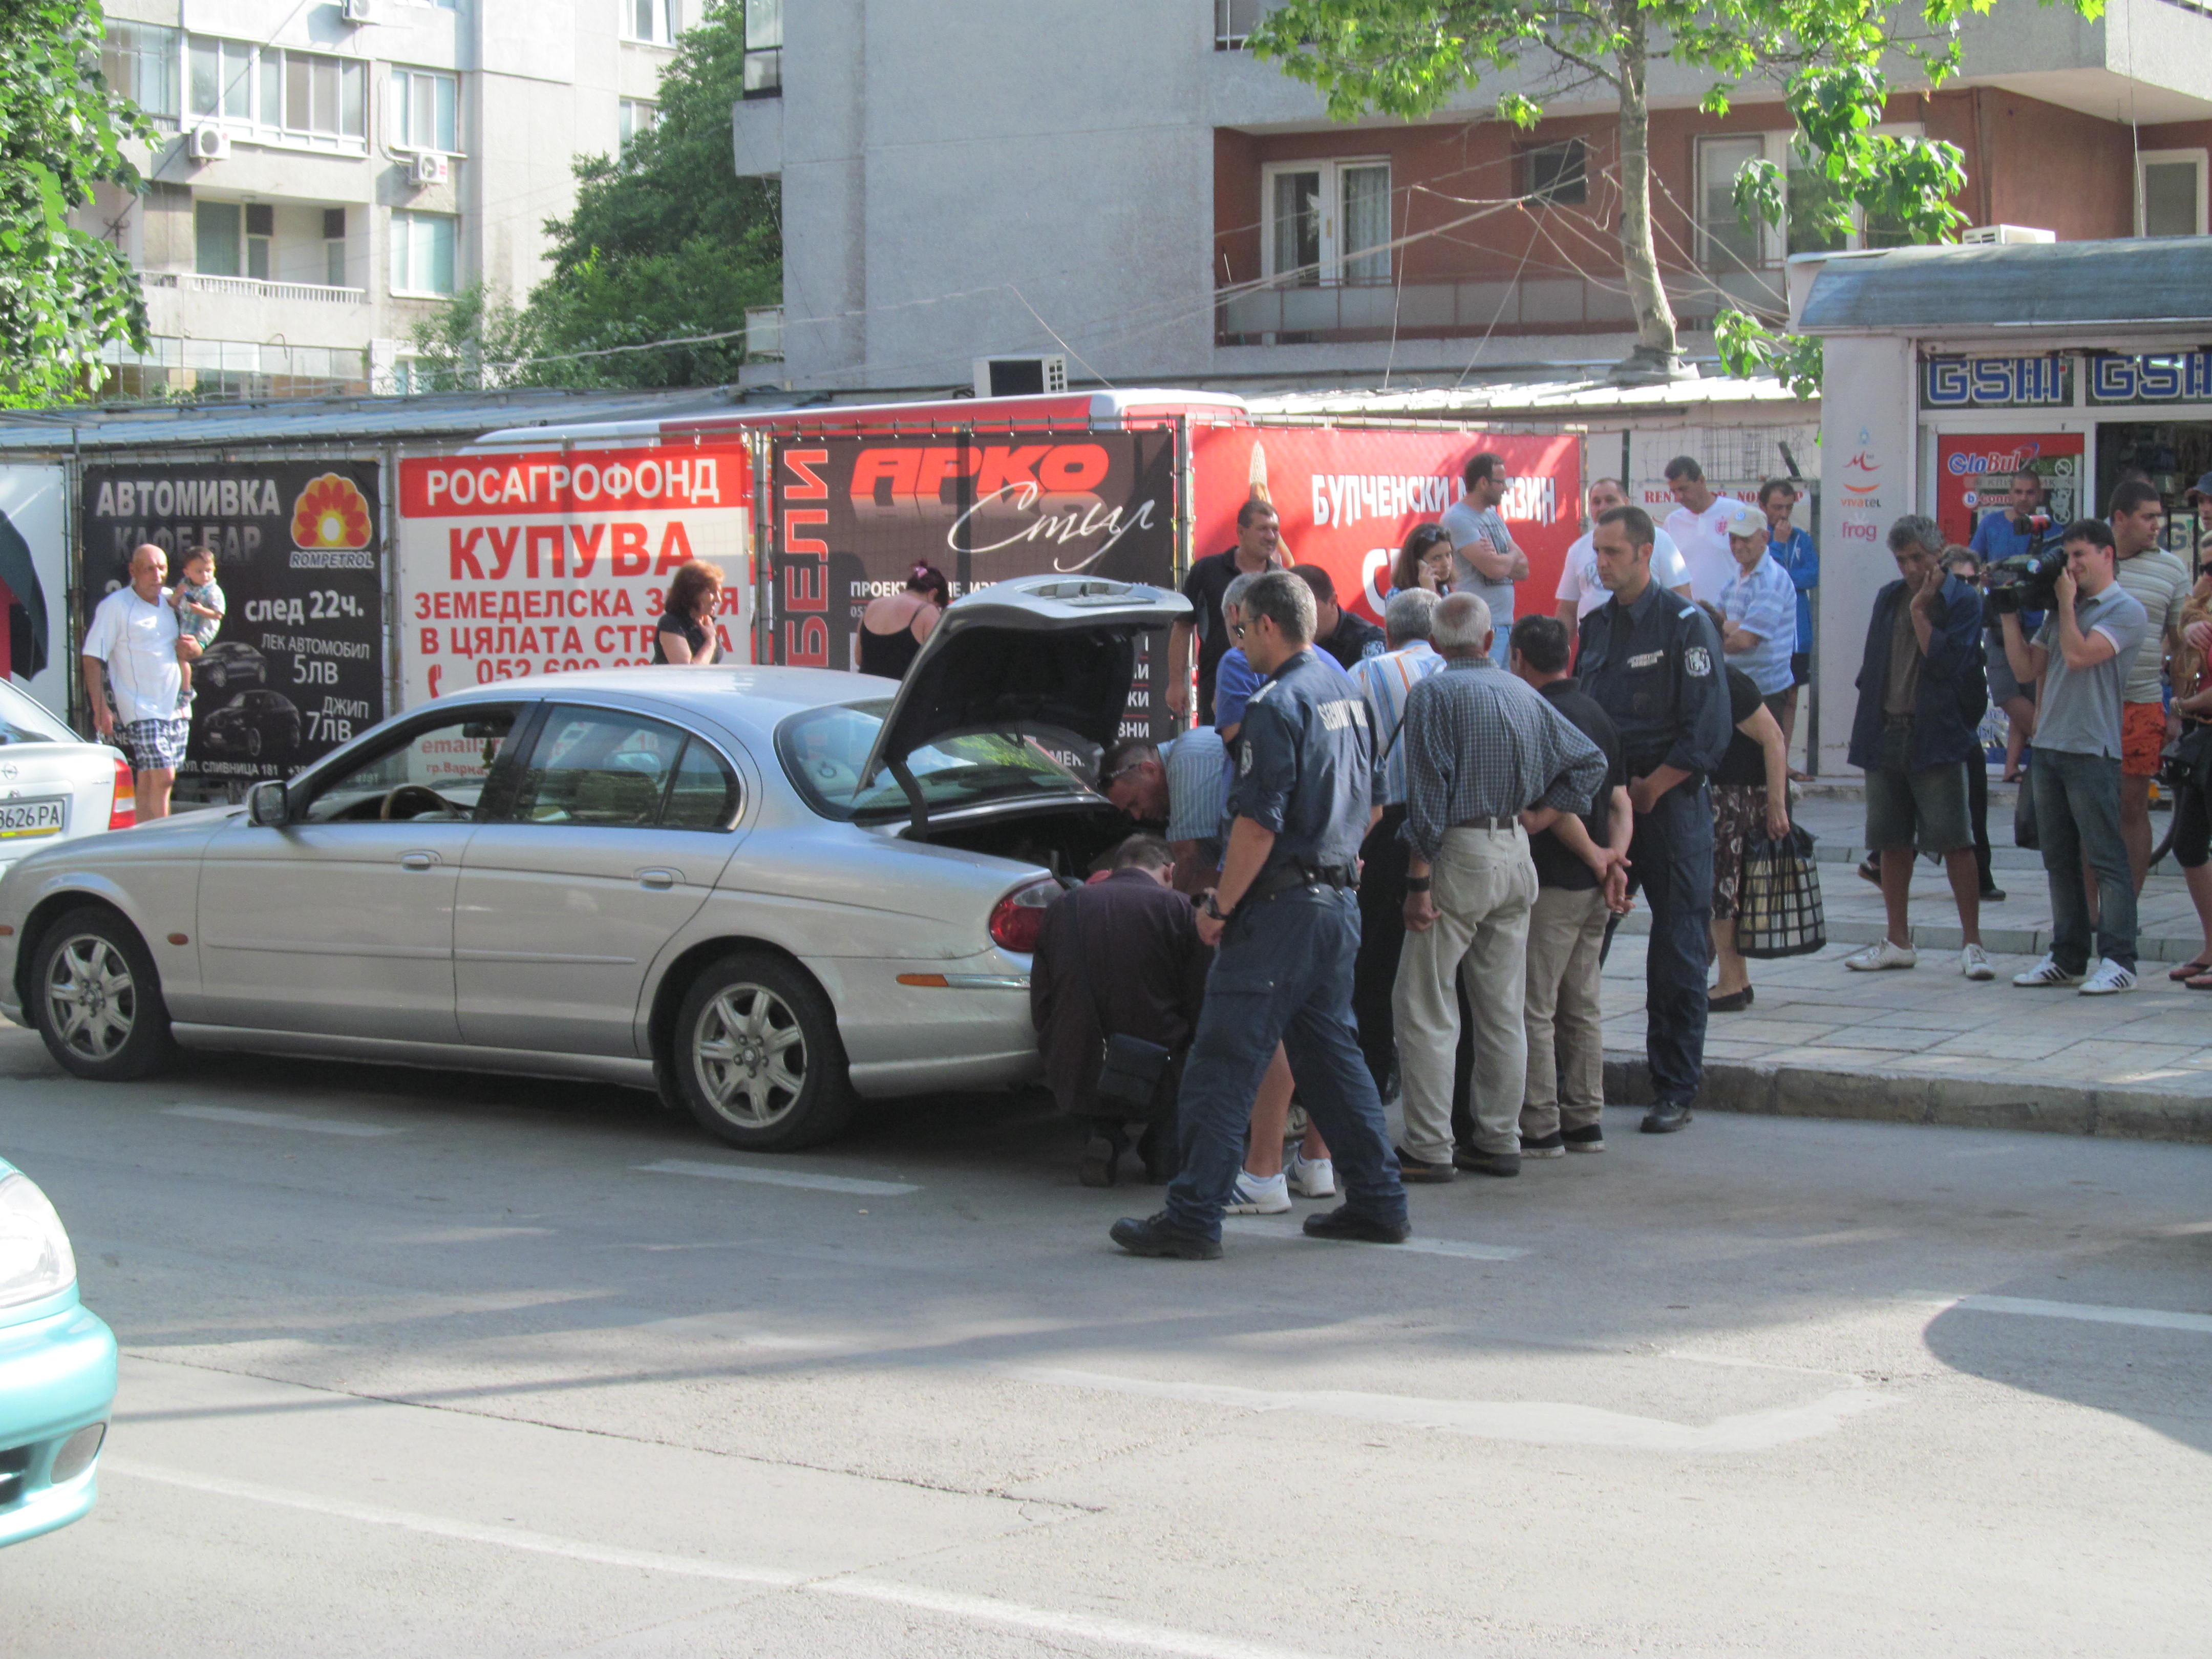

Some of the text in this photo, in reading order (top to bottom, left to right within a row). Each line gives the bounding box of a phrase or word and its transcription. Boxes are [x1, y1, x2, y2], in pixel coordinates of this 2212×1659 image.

[1927, 357, 2064, 405] GSM
[427, 459, 720, 506] РОСАГРОФОНД
[850, 443, 1110, 494] АРКО
[96, 479, 281, 517] АВТОМИВКА
[1312, 474, 1450, 529] БУЛЧЕНСКИ
[202, 526, 262, 563] БАР
[947, 481, 1155, 573] Стил
[1842, 521, 1877, 542] frog
[289, 550, 374, 569] ROMPETROL
[449, 521, 695, 580] КУПУВА
[245, 590, 364, 626] след 22ч.
[414, 589, 634, 624] ЗЕМЕДЕЛСКА
[261, 633, 370, 659] ЛЕК АВТОМОБИЛ
[420, 628, 439, 655] В
[451, 625, 583, 659] ЦЯЛАТА
[324, 696, 369, 719] ДЖИП
